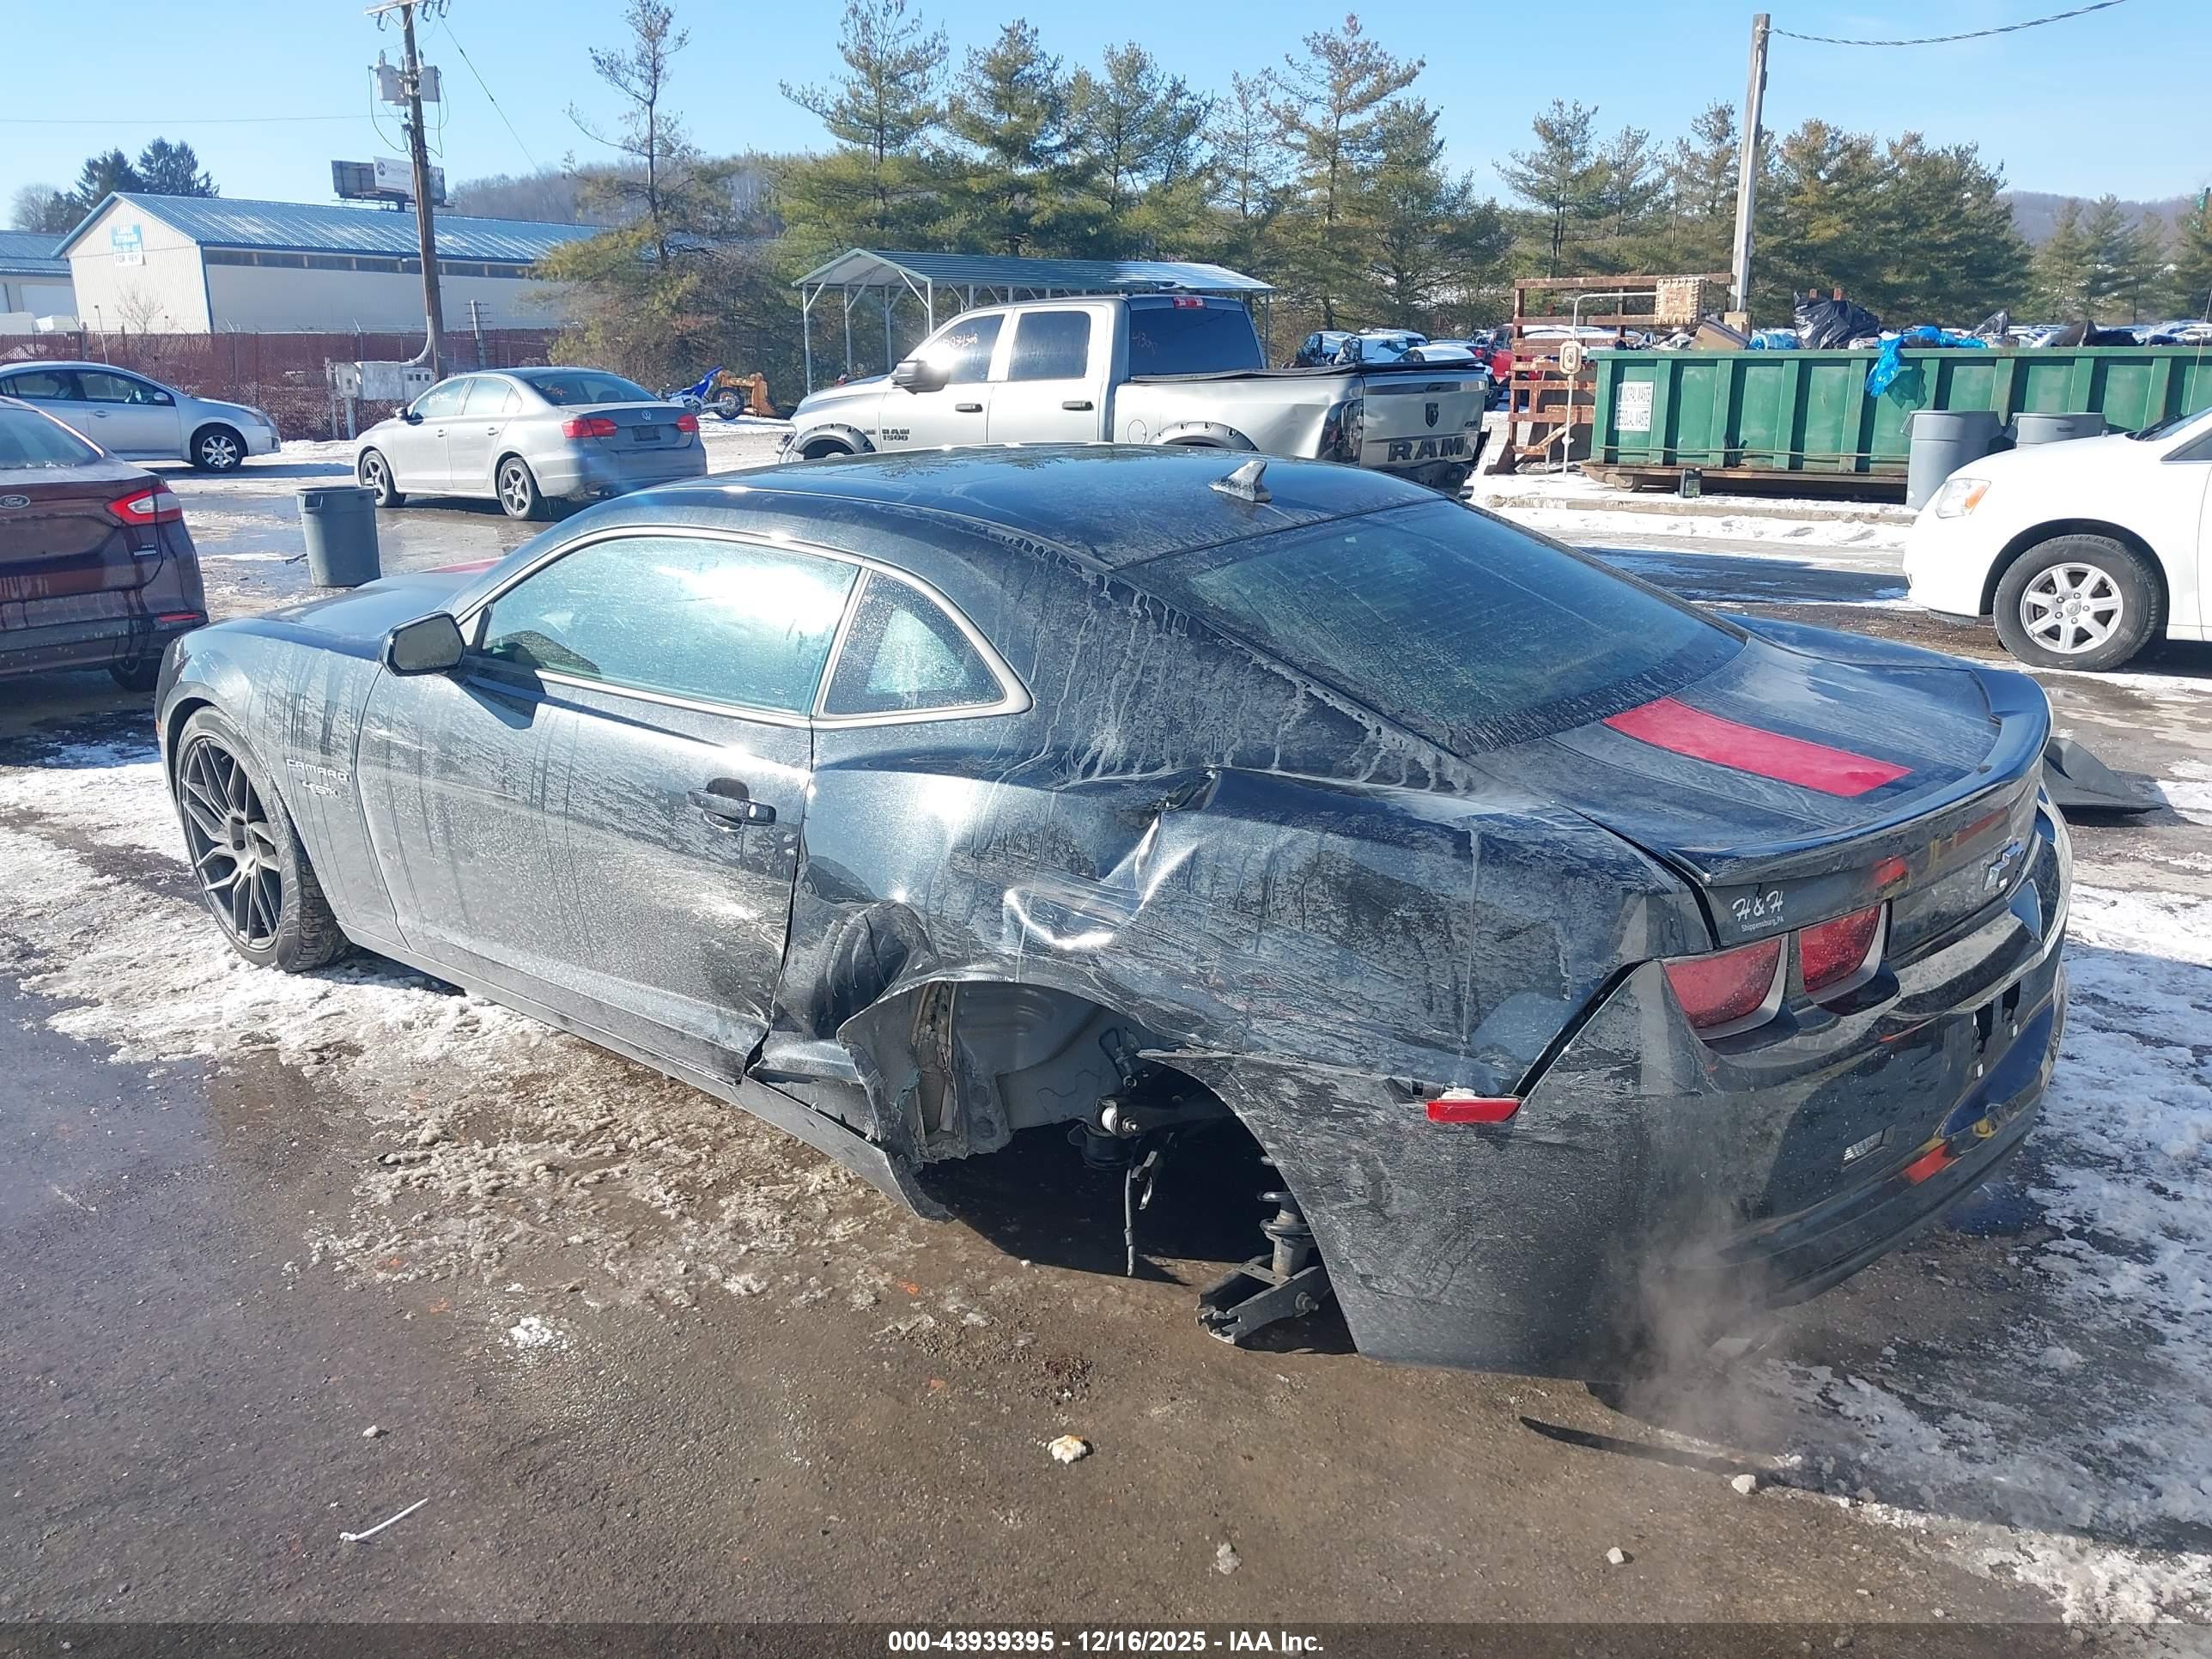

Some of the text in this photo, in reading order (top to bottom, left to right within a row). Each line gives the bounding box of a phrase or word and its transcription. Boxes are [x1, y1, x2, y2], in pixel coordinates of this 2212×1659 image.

[115, 254, 125, 263] FOR
[1638, 386, 1650, 402] WASTE
[1636, 410, 1649, 427] WASTE
[1387, 436, 1466, 462] RAM
[286, 758, 349, 781] CAMARO
[1732, 890, 1784, 922] H & H
